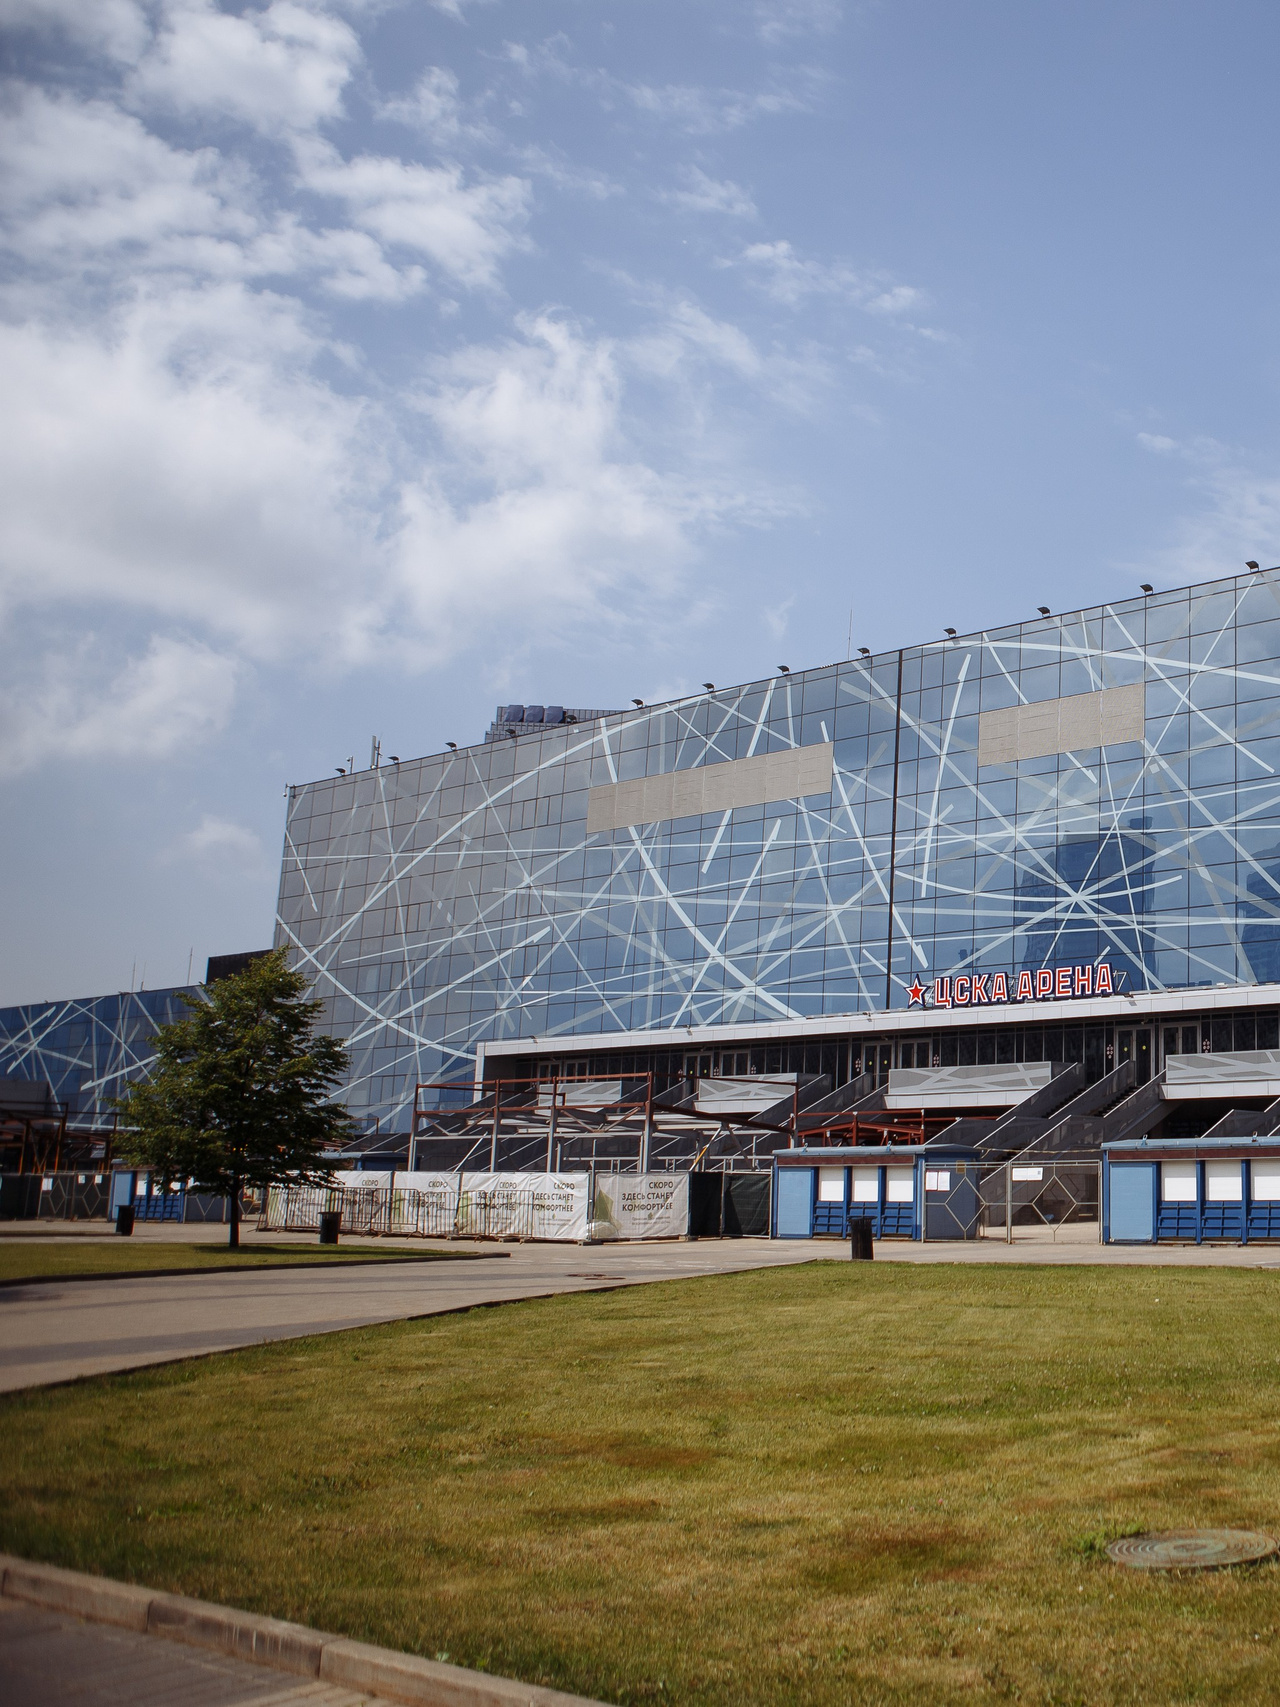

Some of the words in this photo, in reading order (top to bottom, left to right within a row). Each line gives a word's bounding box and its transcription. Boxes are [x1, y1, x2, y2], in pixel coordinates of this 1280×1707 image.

[934, 972, 1008, 1009] ЦСКА
[1016, 963, 1113, 1000] АРЕНА
[500, 1181, 518, 1190] СКОРО
[553, 1182, 576, 1190] СКОРО
[648, 1181, 674, 1189] СКОРО
[551, 1193, 575, 1201] СТАНЕТ
[621, 1192, 646, 1201] ЗДЕСЬ
[646, 1191, 674, 1200] СТАНЕТ
[622, 1202, 673, 1212] КОМФОРТНЕЕ
